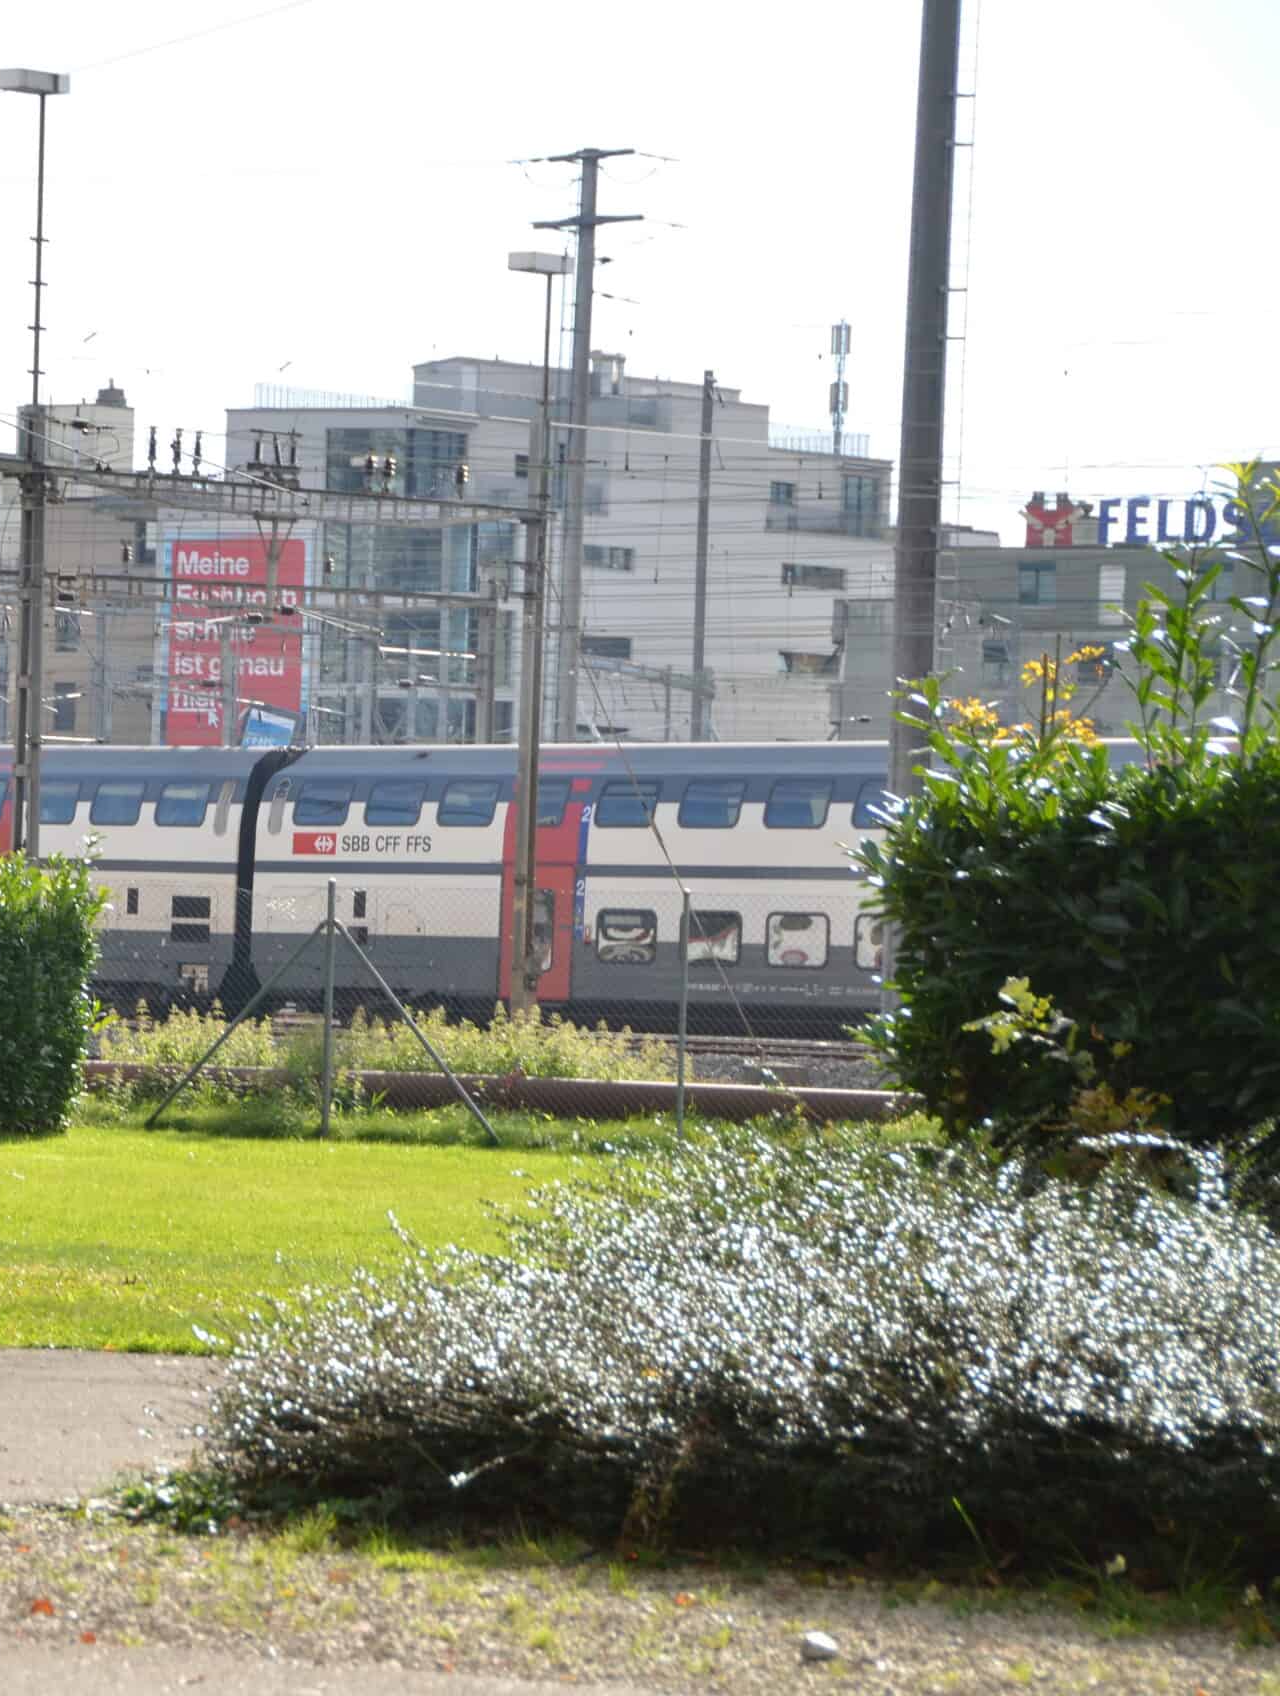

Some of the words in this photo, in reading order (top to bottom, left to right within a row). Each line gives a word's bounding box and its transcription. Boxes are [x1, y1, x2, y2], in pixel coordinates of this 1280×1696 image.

[1097, 496, 1280, 545] FELDS
[177, 551, 250, 576] Meine
[175, 652, 204, 675] ist
[208, 656, 284, 681] gnau
[581, 805, 592, 823] 2
[341, 835, 370, 852] SBB
[375, 835, 401, 853] CFF
[406, 835, 432, 853] FFS
[576, 879, 586, 896] 2
